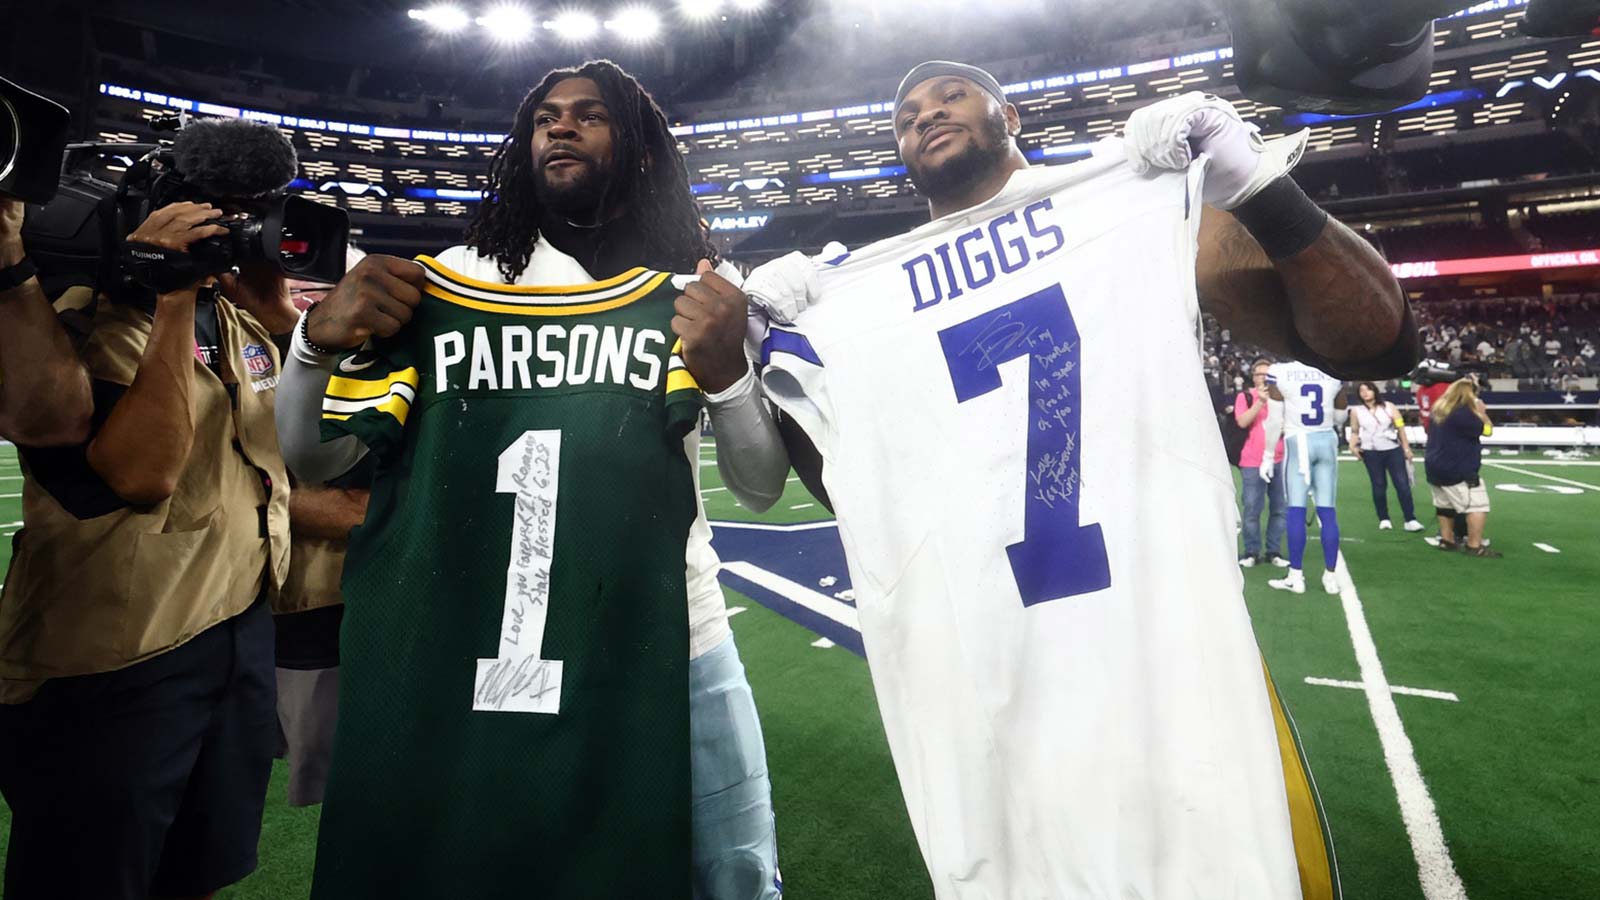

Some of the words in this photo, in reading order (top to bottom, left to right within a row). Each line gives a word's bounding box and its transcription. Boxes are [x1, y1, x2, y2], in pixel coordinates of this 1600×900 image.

[710, 216, 768, 230] ASHLEY
[902, 198, 1065, 312] DIGGS
[1531, 253, 1579, 267] OFFICIAL
[247, 356, 272, 372] NFL
[433, 324, 666, 393] PARSONS
[251, 375, 280, 392] MEDI
[1301, 384, 1324, 426] 3
[937, 282, 1111, 608] 7
[472, 428, 563, 714] 1
